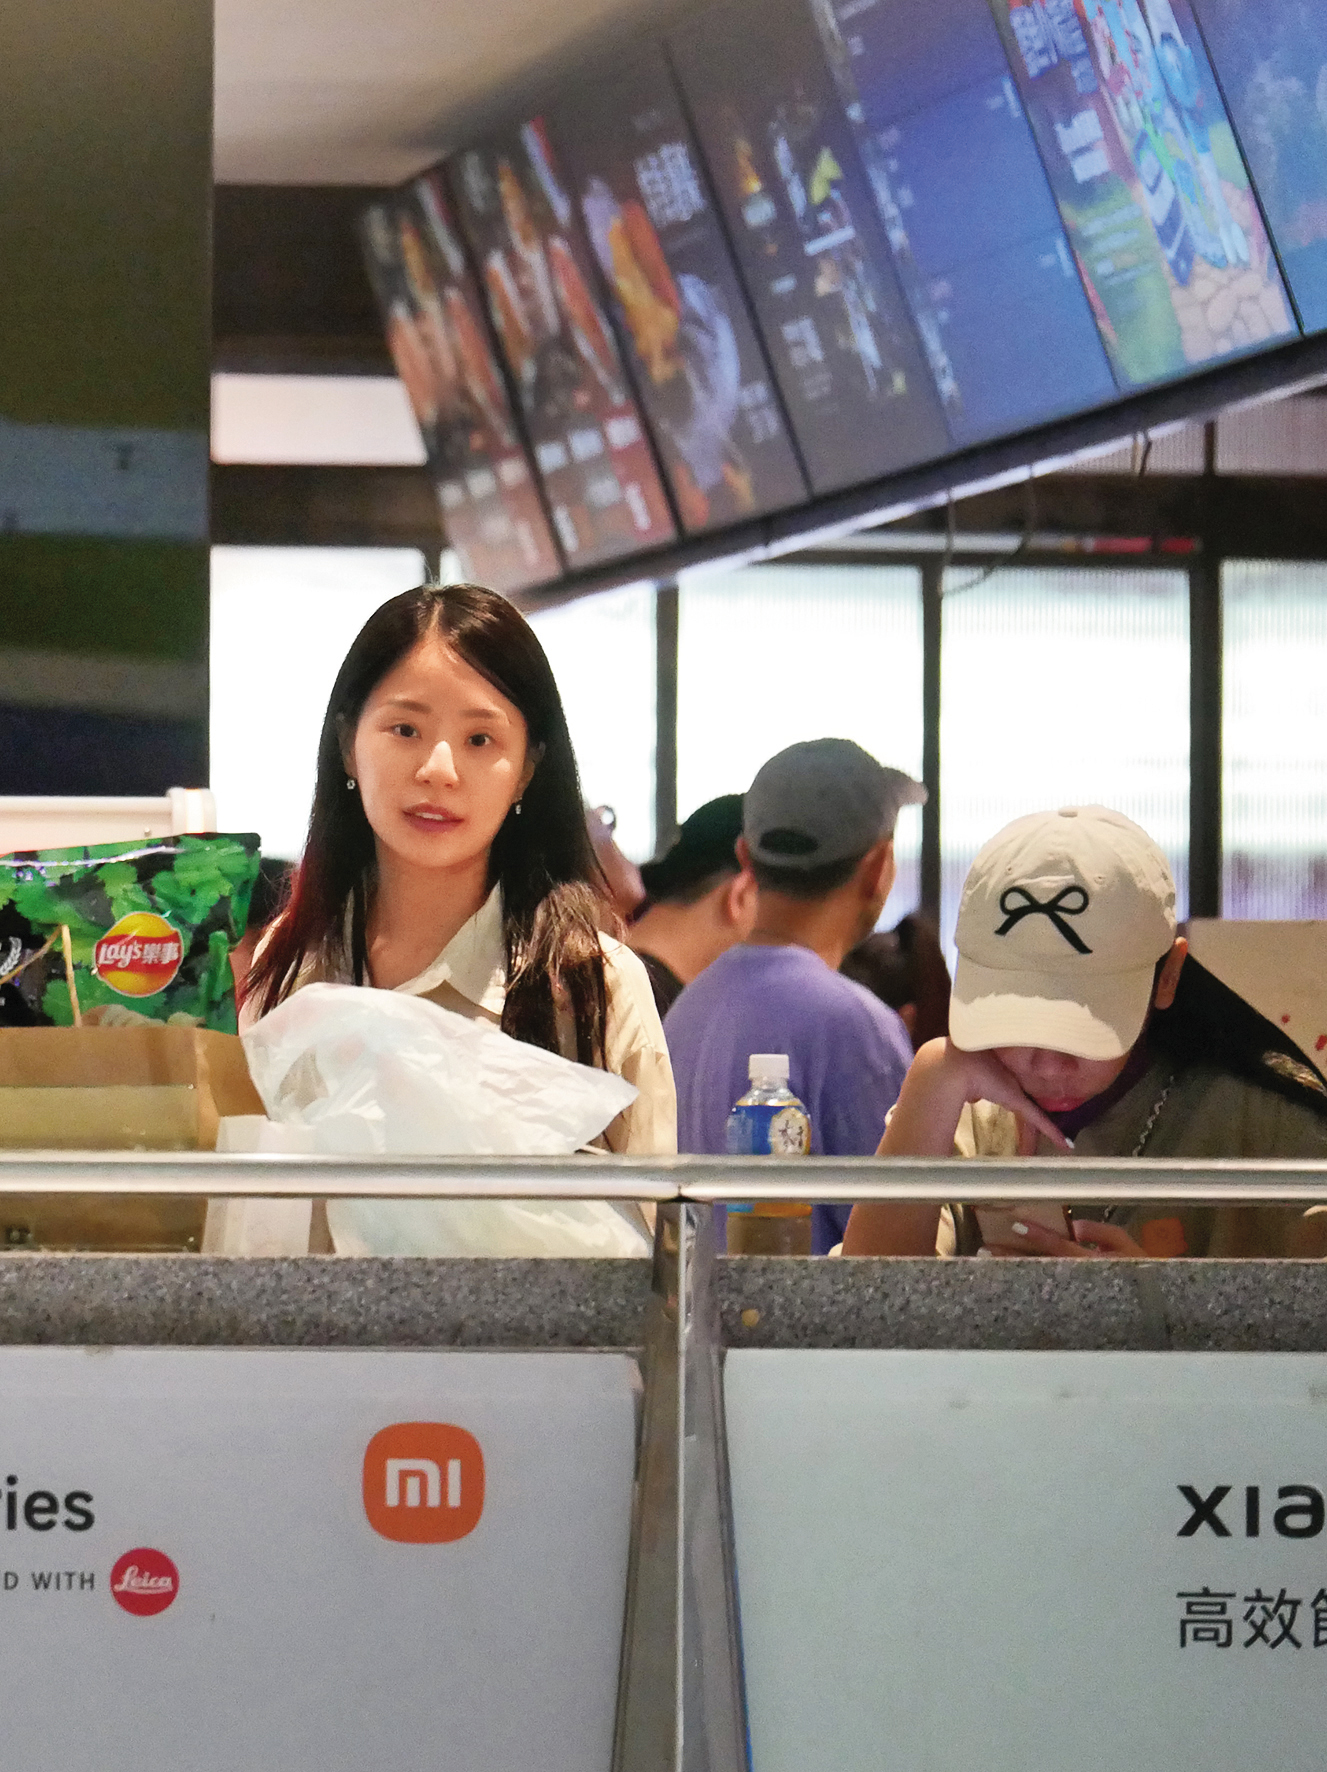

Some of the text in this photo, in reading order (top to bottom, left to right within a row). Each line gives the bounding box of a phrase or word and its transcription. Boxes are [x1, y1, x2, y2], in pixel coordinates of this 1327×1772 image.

[98, 941, 142, 968] Lay's
[32, 1571, 96, 1591] WITH
[113, 1564, 173, 1595] Leica
